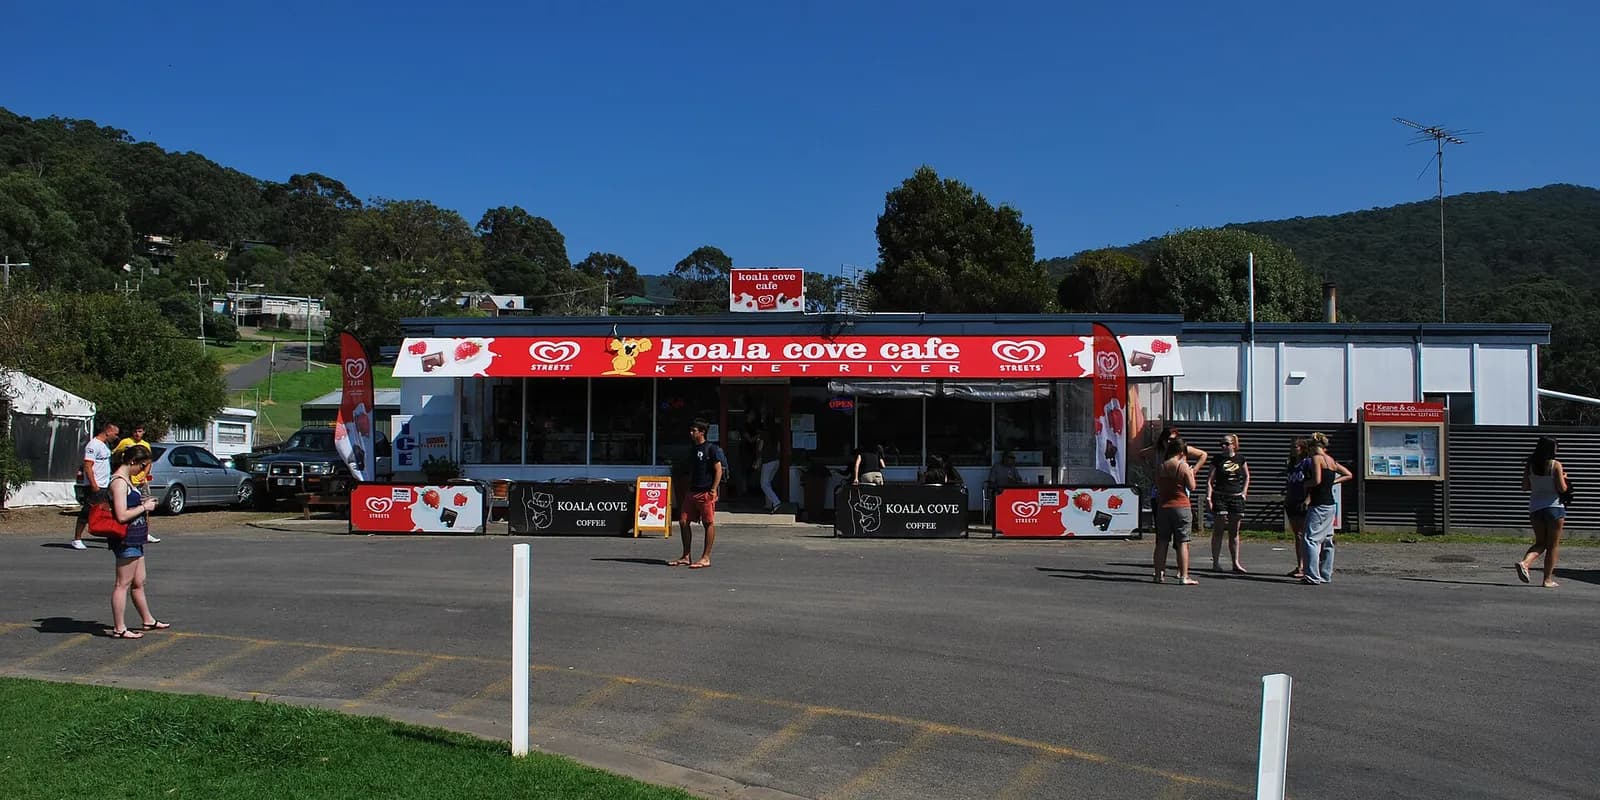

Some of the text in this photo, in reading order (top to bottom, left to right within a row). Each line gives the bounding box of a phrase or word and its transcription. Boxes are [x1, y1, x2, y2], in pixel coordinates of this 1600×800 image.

[738, 272, 796, 281] koala cove
[755, 281, 778, 290] cafe
[658, 337, 960, 360] koala cove cafe
[530, 363, 571, 371] STREETS
[655, 364, 961, 373] KENNET RIVER
[999, 364, 1041, 372] STREETS
[829, 400, 854, 408] OPEN
[396, 421, 415, 466] ICE
[557, 501, 628, 512] KOALA COVE
[886, 503, 960, 514] KOALA COVE
[576, 519, 607, 527] COFFEE
[905, 522, 937, 530] COFFEE
